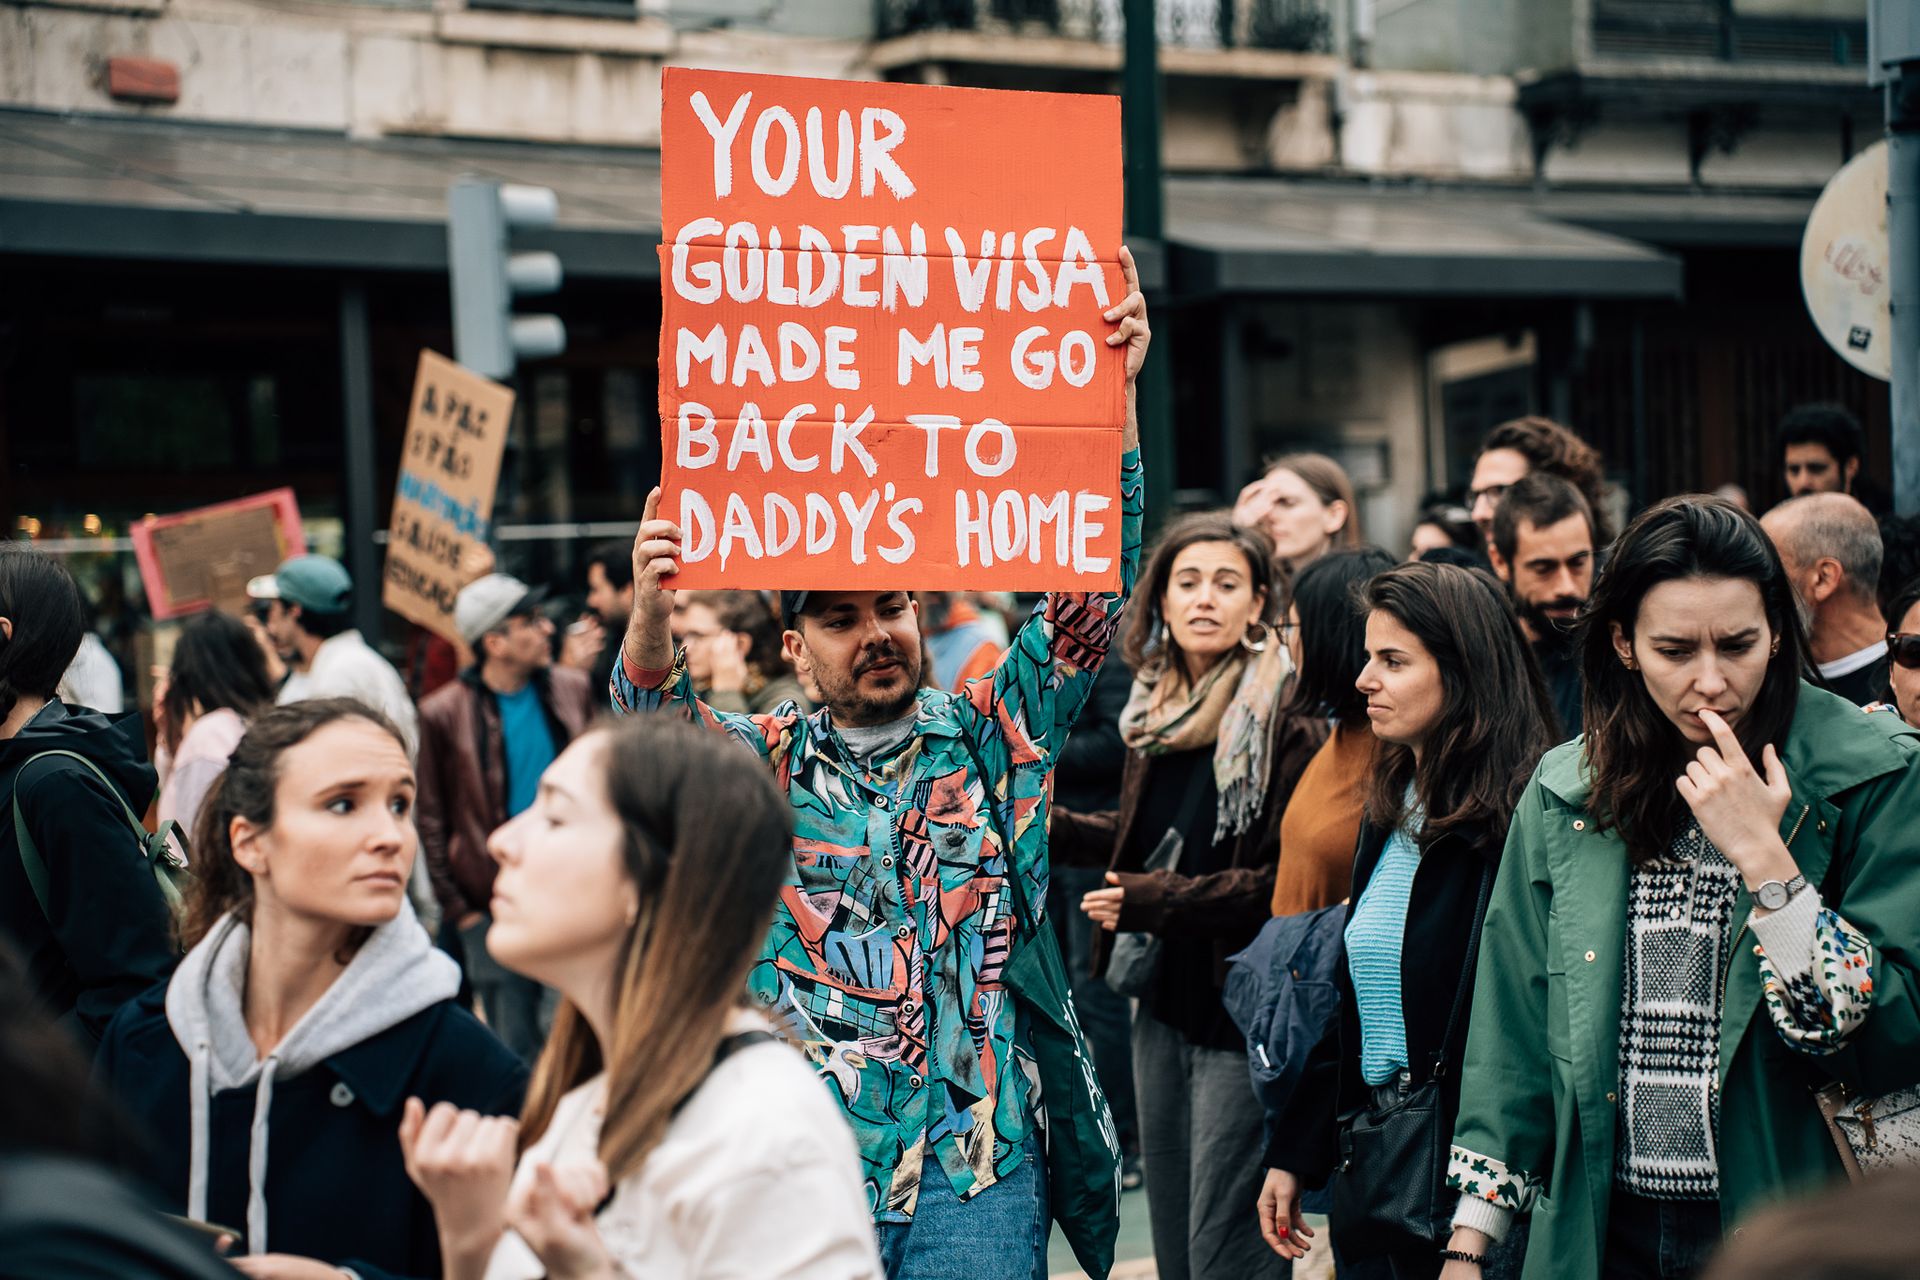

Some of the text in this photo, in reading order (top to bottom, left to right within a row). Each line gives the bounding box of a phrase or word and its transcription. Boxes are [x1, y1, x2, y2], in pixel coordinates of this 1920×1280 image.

[690, 91, 916, 201] YOUR
[672, 218, 1111, 314] GOLDEN VISA
[676, 322, 1096, 391] MADE ME GO
[677, 402, 1017, 478] BACK TO
[679, 482, 1111, 575] DADDY'S HOME
